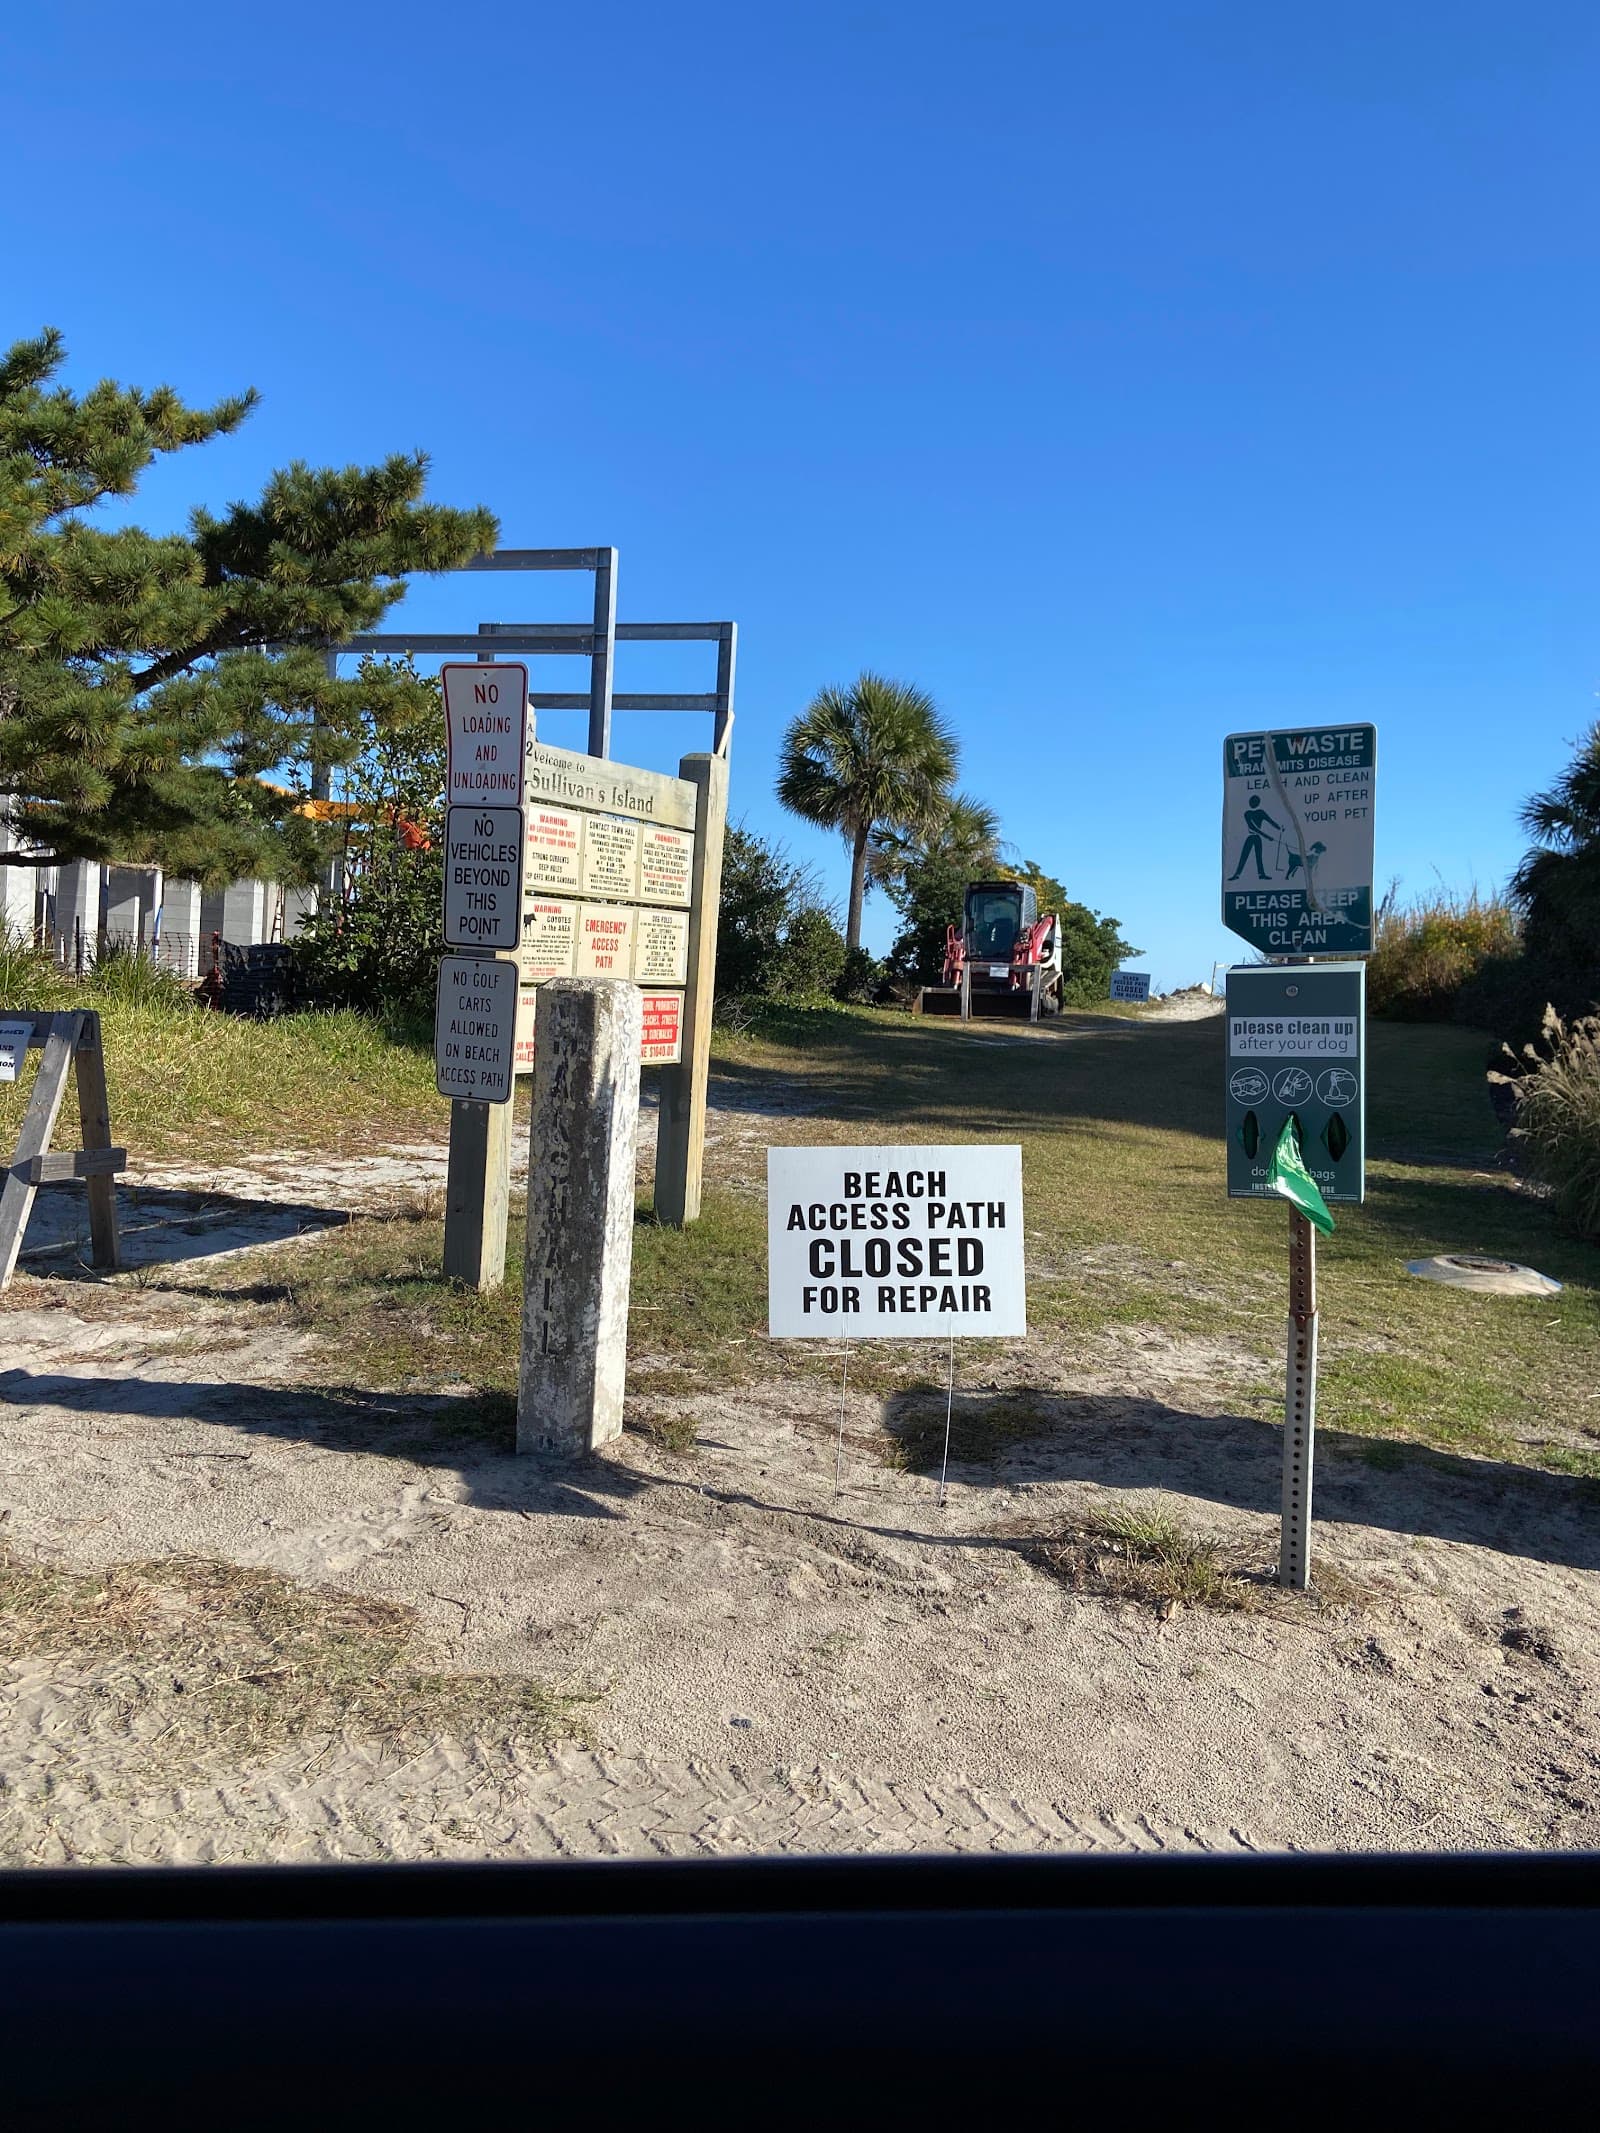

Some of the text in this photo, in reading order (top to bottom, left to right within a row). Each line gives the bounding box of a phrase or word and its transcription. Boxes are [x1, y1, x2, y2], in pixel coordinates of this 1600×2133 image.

[474, 684, 499, 704] NO
[463, 716, 511, 733] LOADING
[1286, 731, 1364, 756] WASTE
[475, 745, 497, 761] AND
[576, 762, 585, 774] to
[1237, 754, 1361, 776] TRANMITS DISEASE
[454, 772, 516, 790] UNLOADING
[1247, 771, 1369, 790] LEAH AND CLEAN
[530, 767, 654, 814] Sullivan's Island
[1304, 789, 1369, 804] UP AFTER
[539, 814, 568, 828] WARNING
[1304, 807, 1368, 822] YOUR PET
[474, 818, 494, 837] NO
[451, 842, 517, 863] VEHICLES
[454, 867, 510, 887] BEYOND
[466, 892, 496, 911] THIS
[534, 904, 562, 914] WARNING
[1235, 891, 1359, 910] PLEASE EEP
[459, 916, 501, 936] POINT
[546, 915, 572, 924] COYOTES
[585, 919, 627, 934] EMERGENCY
[1249, 910, 1345, 928] THIS AREA
[591, 937, 619, 952] ACCESS
[1269, 929, 1327, 945] CLEAN
[595, 955, 613, 969] PATH
[453, 972, 499, 988] NO GOLF
[459, 996, 491, 1013] CARTS
[450, 1019, 498, 1038] ALLOWED
[1233, 1020, 1354, 1038] please clean up
[445, 1043, 499, 1062] ON BEACH
[1239, 1036, 1348, 1053] after your dog
[440, 1071, 504, 1088] ACCESS PATH
[1309, 1168, 1336, 1182] bags
[844, 1171, 946, 1198] BEACH
[1321, 1185, 1335, 1194] USE
[787, 1202, 1006, 1231] ACCESS PATH
[809, 1237, 984, 1279] CLOSED
[803, 1285, 992, 1313] FOR REPAIR
